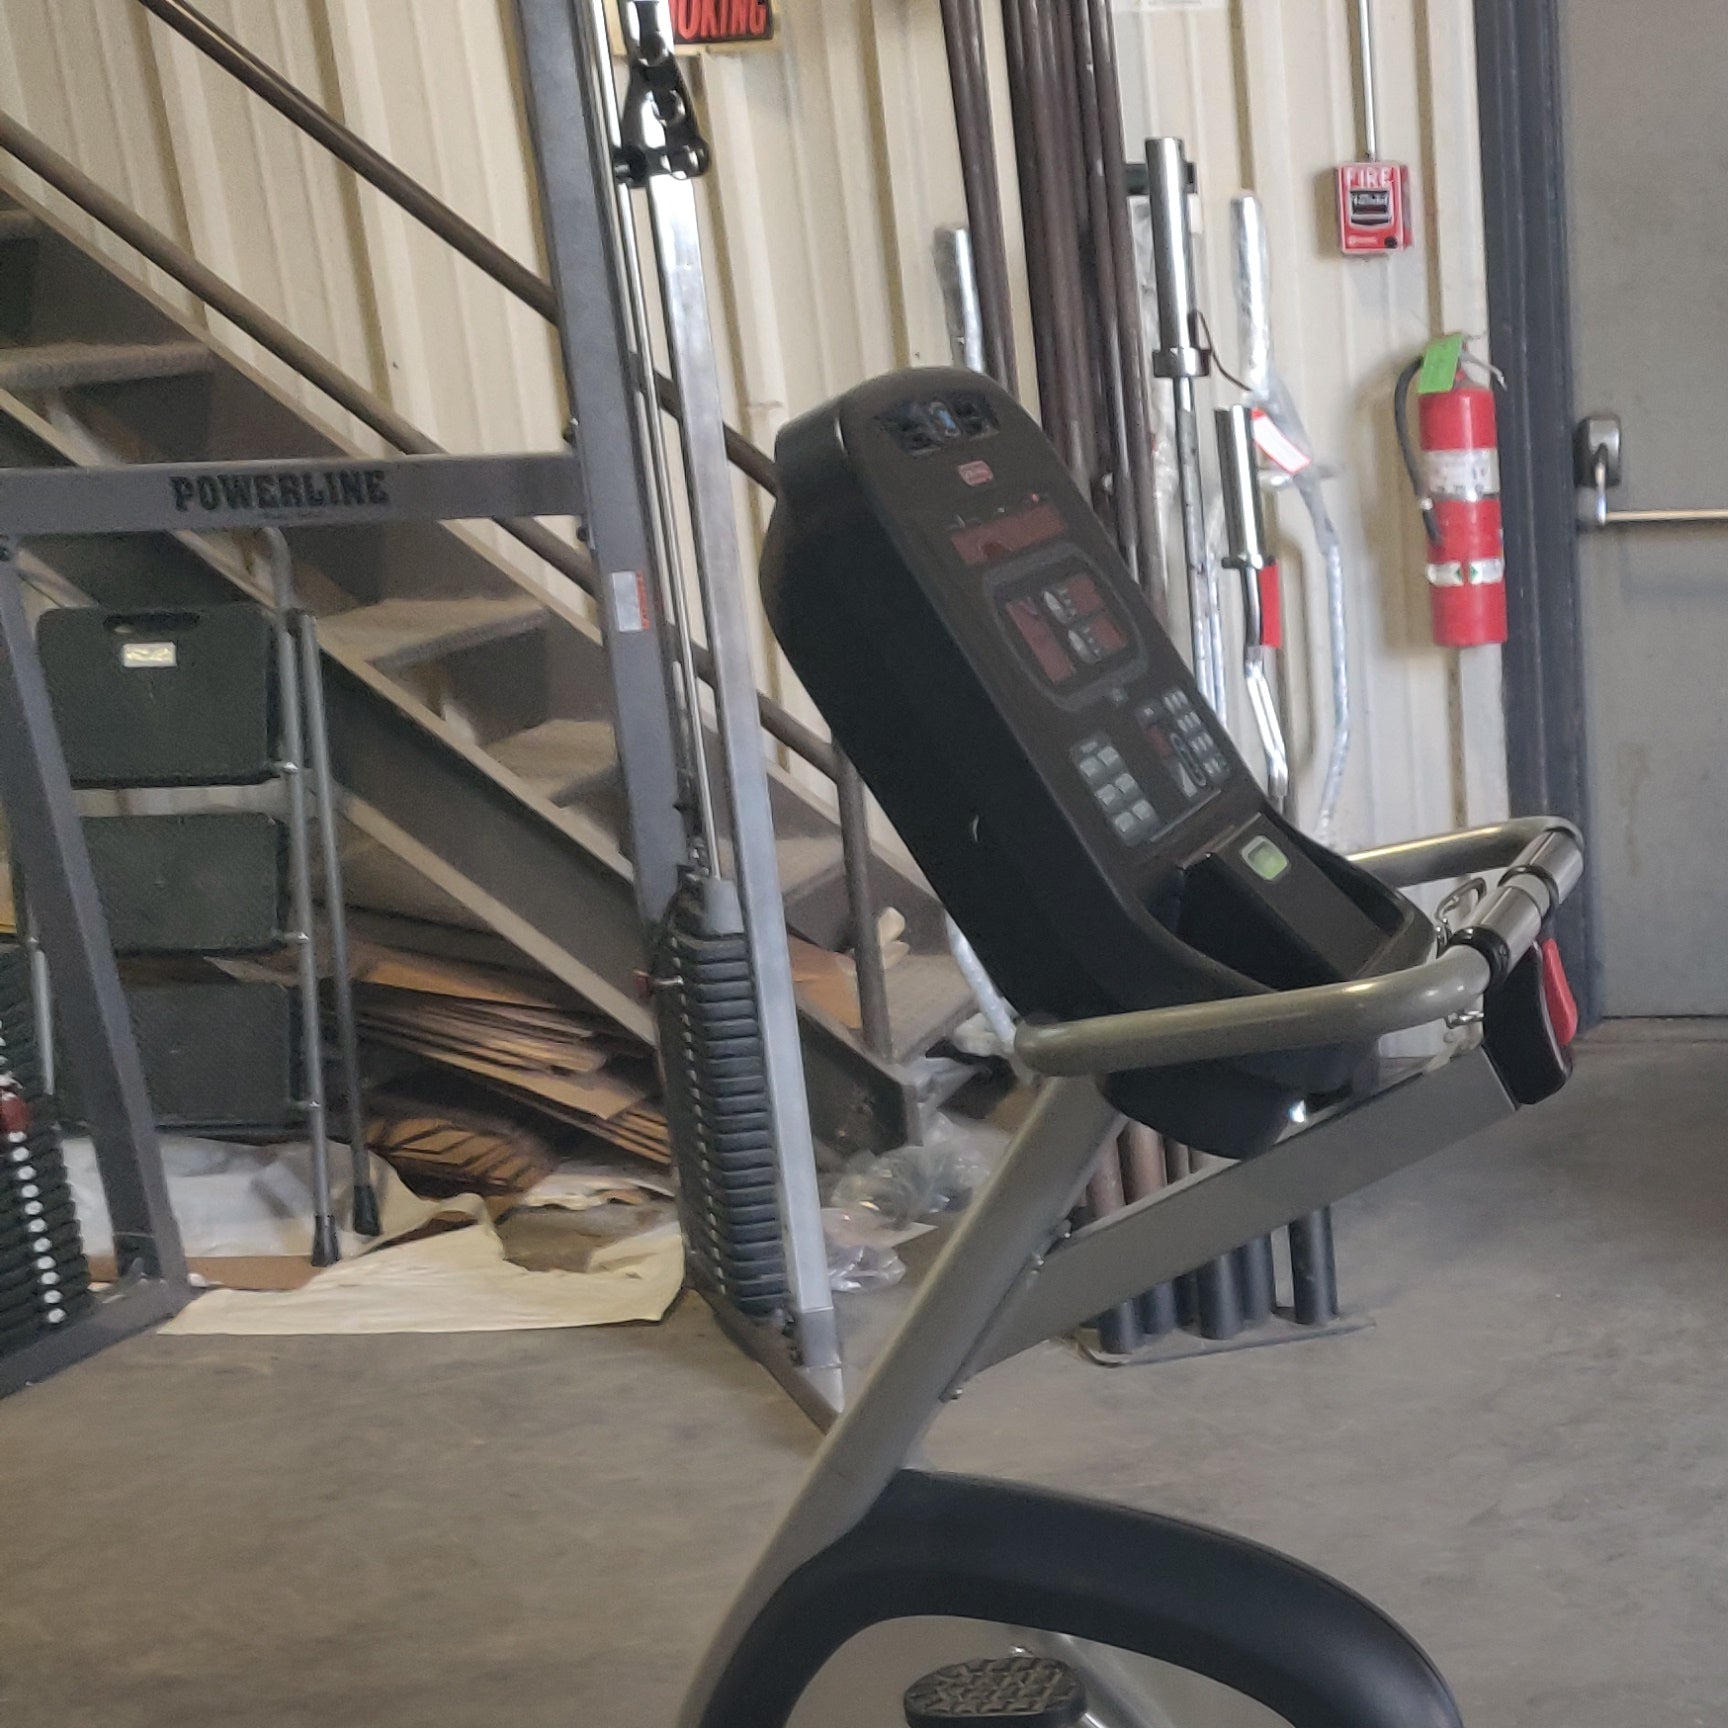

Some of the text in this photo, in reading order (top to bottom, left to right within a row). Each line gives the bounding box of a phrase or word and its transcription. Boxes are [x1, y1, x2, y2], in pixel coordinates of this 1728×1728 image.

[669, 0, 767, 40] OKING
[1345, 166, 1394, 188] FIRE
[169, 469, 391, 512] POWERLINE
